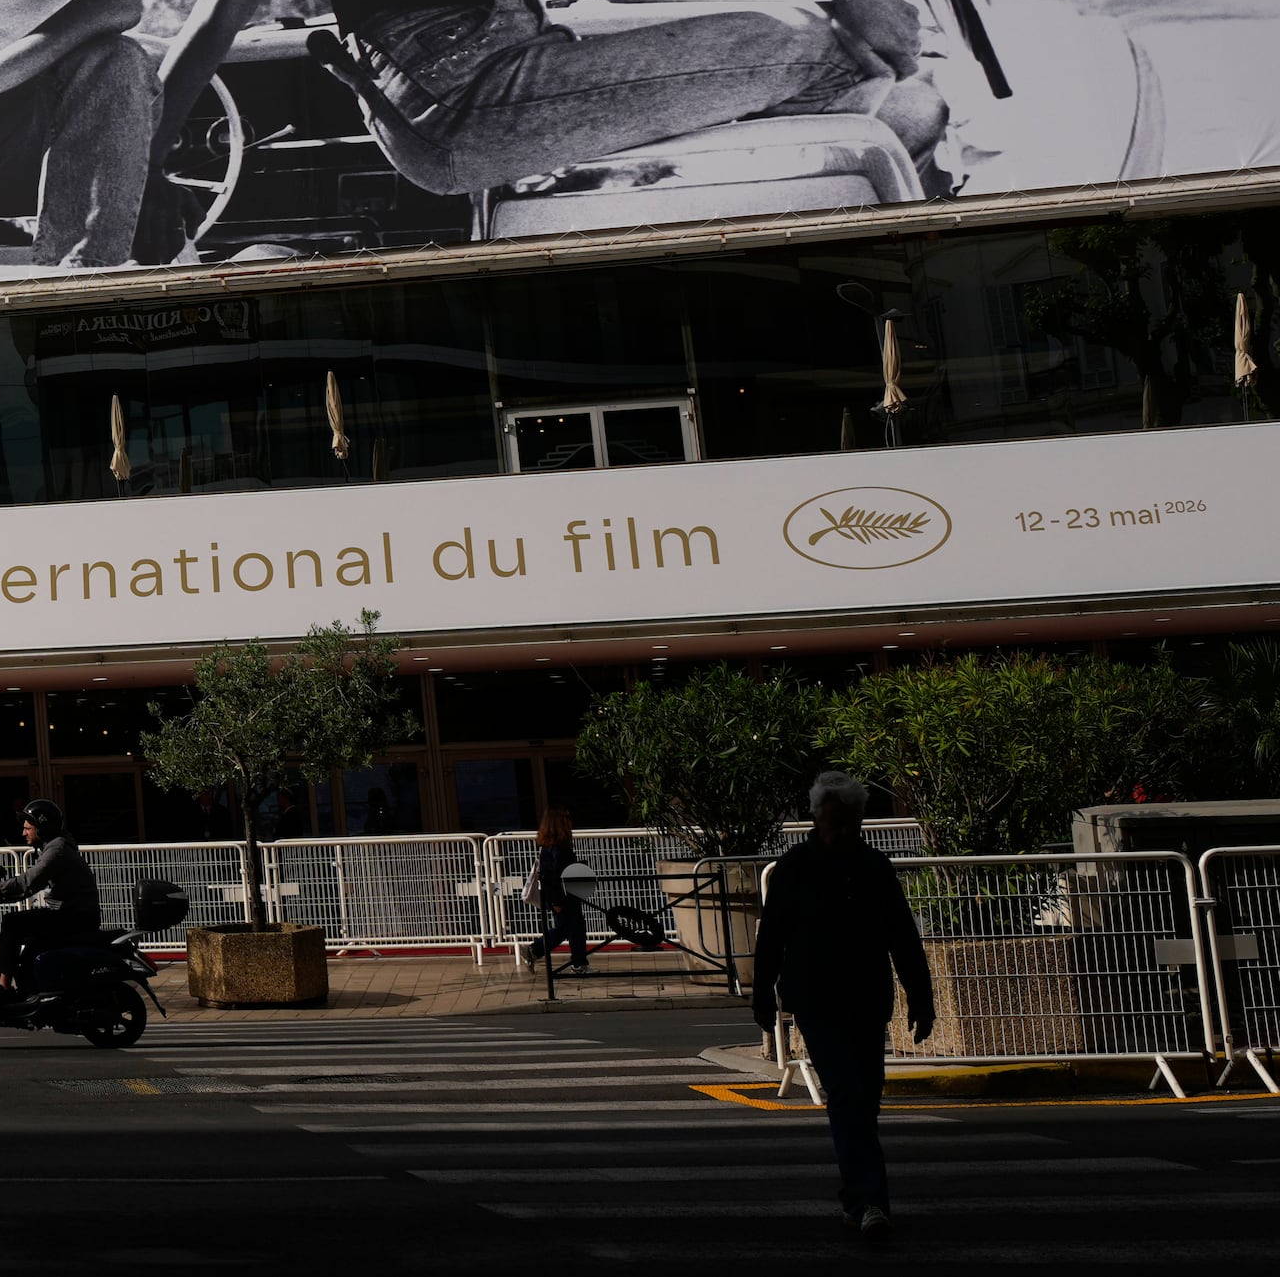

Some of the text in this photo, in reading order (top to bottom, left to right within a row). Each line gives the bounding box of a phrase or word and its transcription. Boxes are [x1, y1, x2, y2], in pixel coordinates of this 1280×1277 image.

[432, 527, 527, 581] du
[563, 516, 721, 573] film
[1109, 503, 1161, 528] mai
[1165, 499, 1208, 515] 2026
